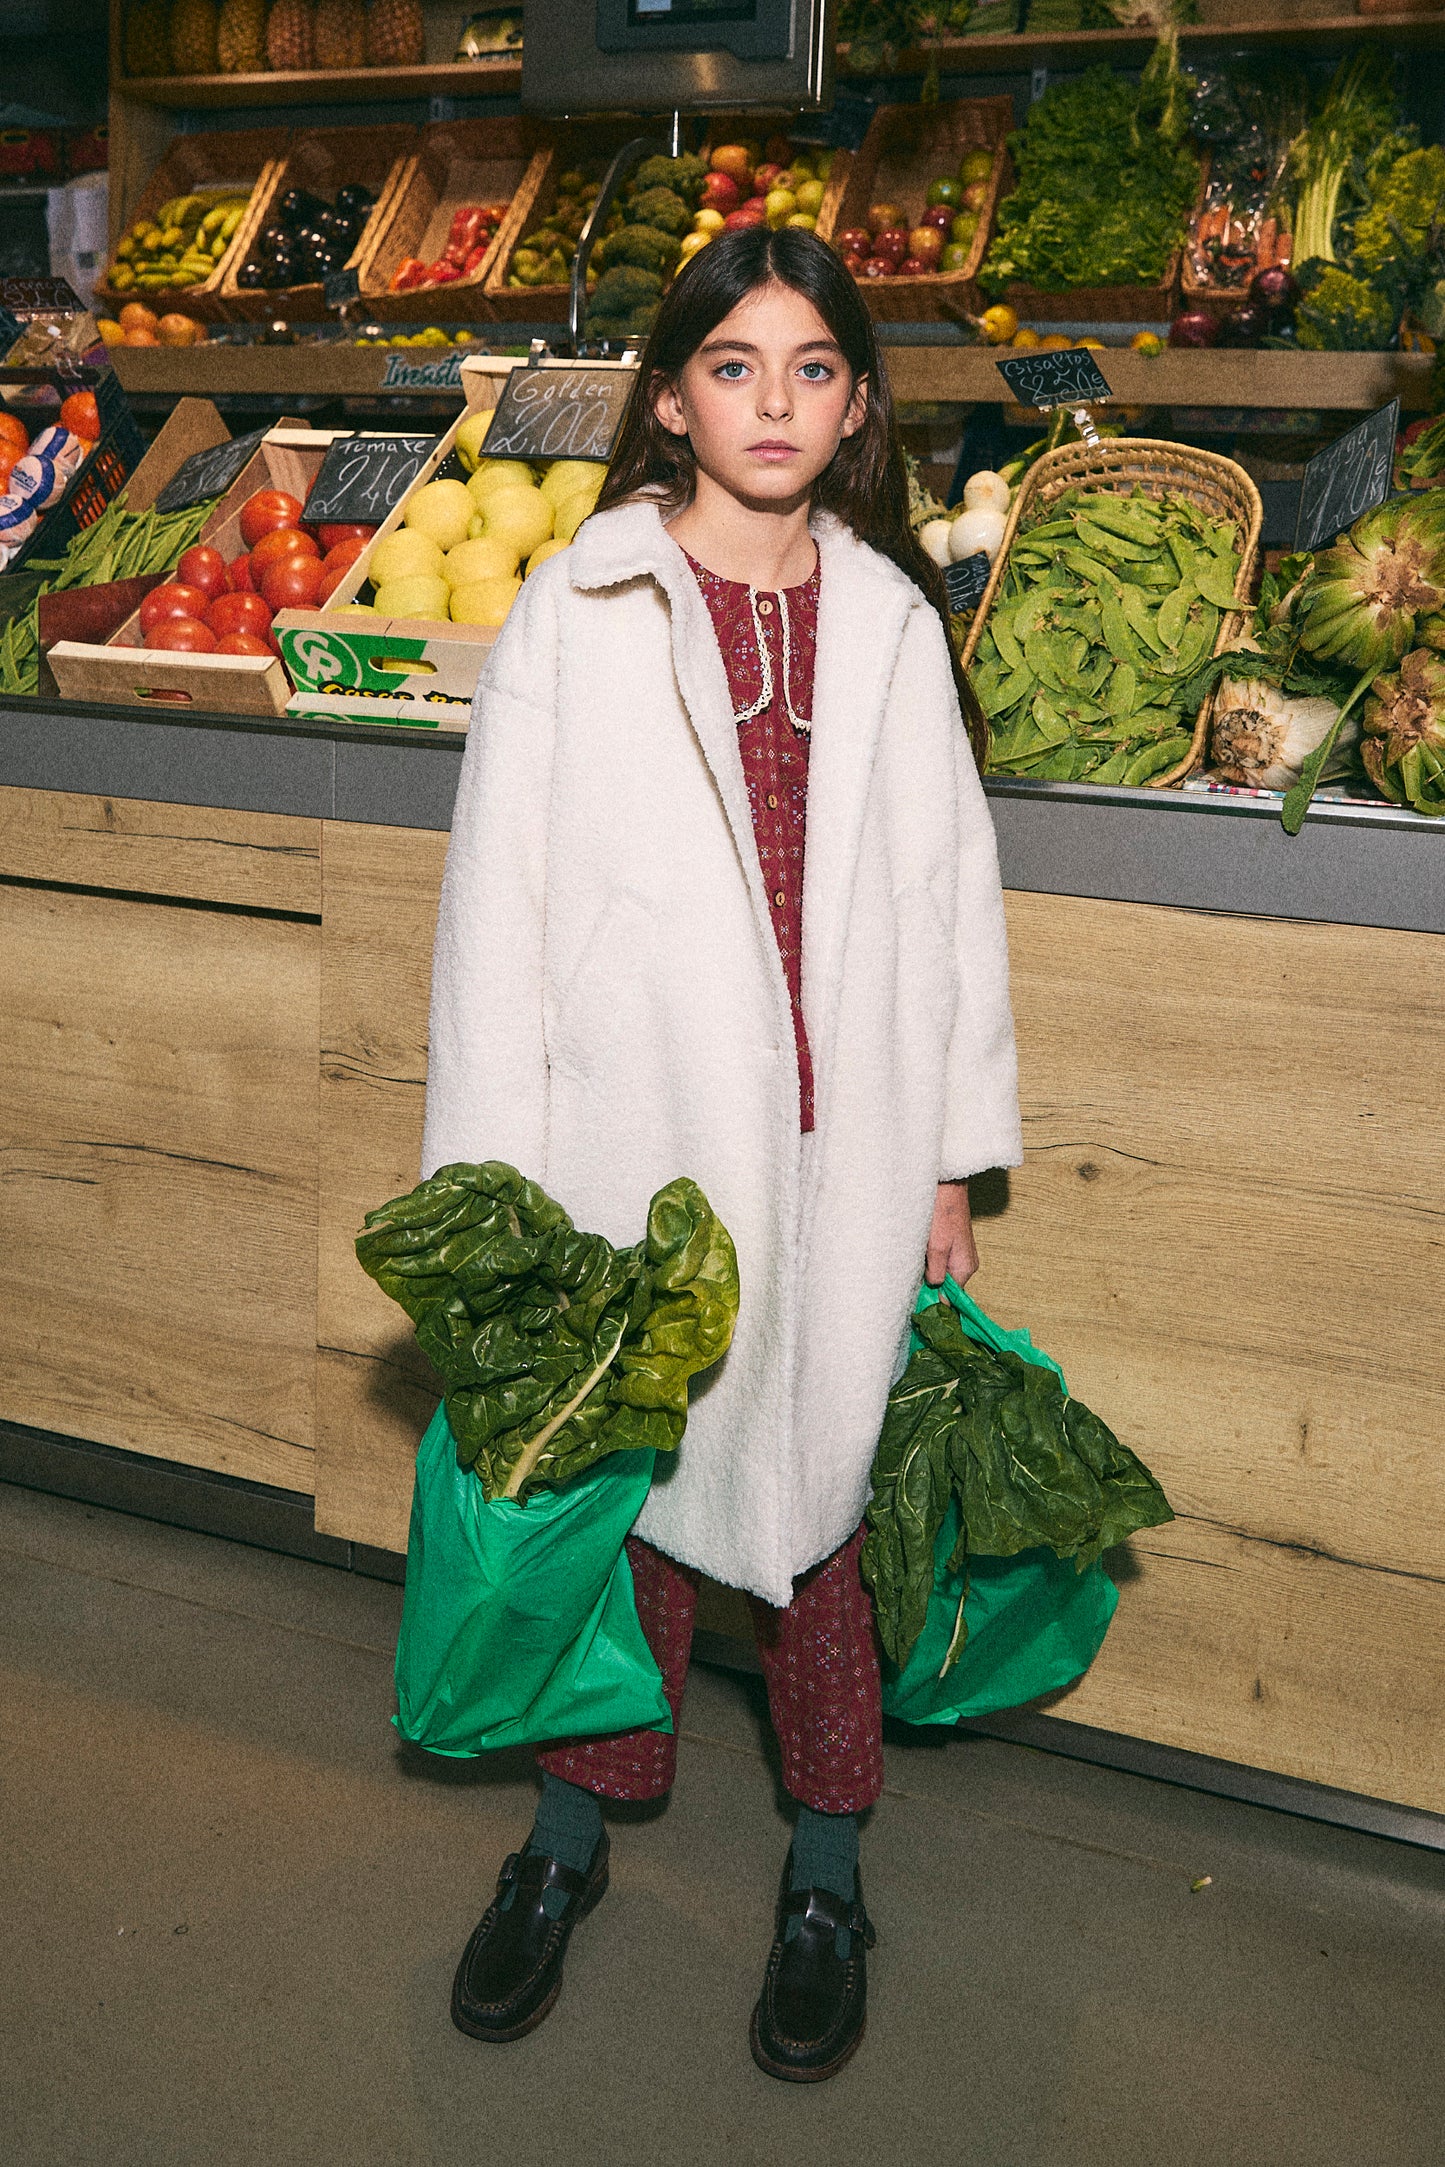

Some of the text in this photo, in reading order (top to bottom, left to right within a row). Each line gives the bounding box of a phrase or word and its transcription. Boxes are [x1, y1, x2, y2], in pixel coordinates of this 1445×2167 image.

[1004, 351, 1091, 377] Bisaltos
[511, 370, 612, 403] Golden
[490, 399, 608, 456] 2,00
[339, 438, 427, 455] Tomate
[311, 454, 419, 514] 2,40
